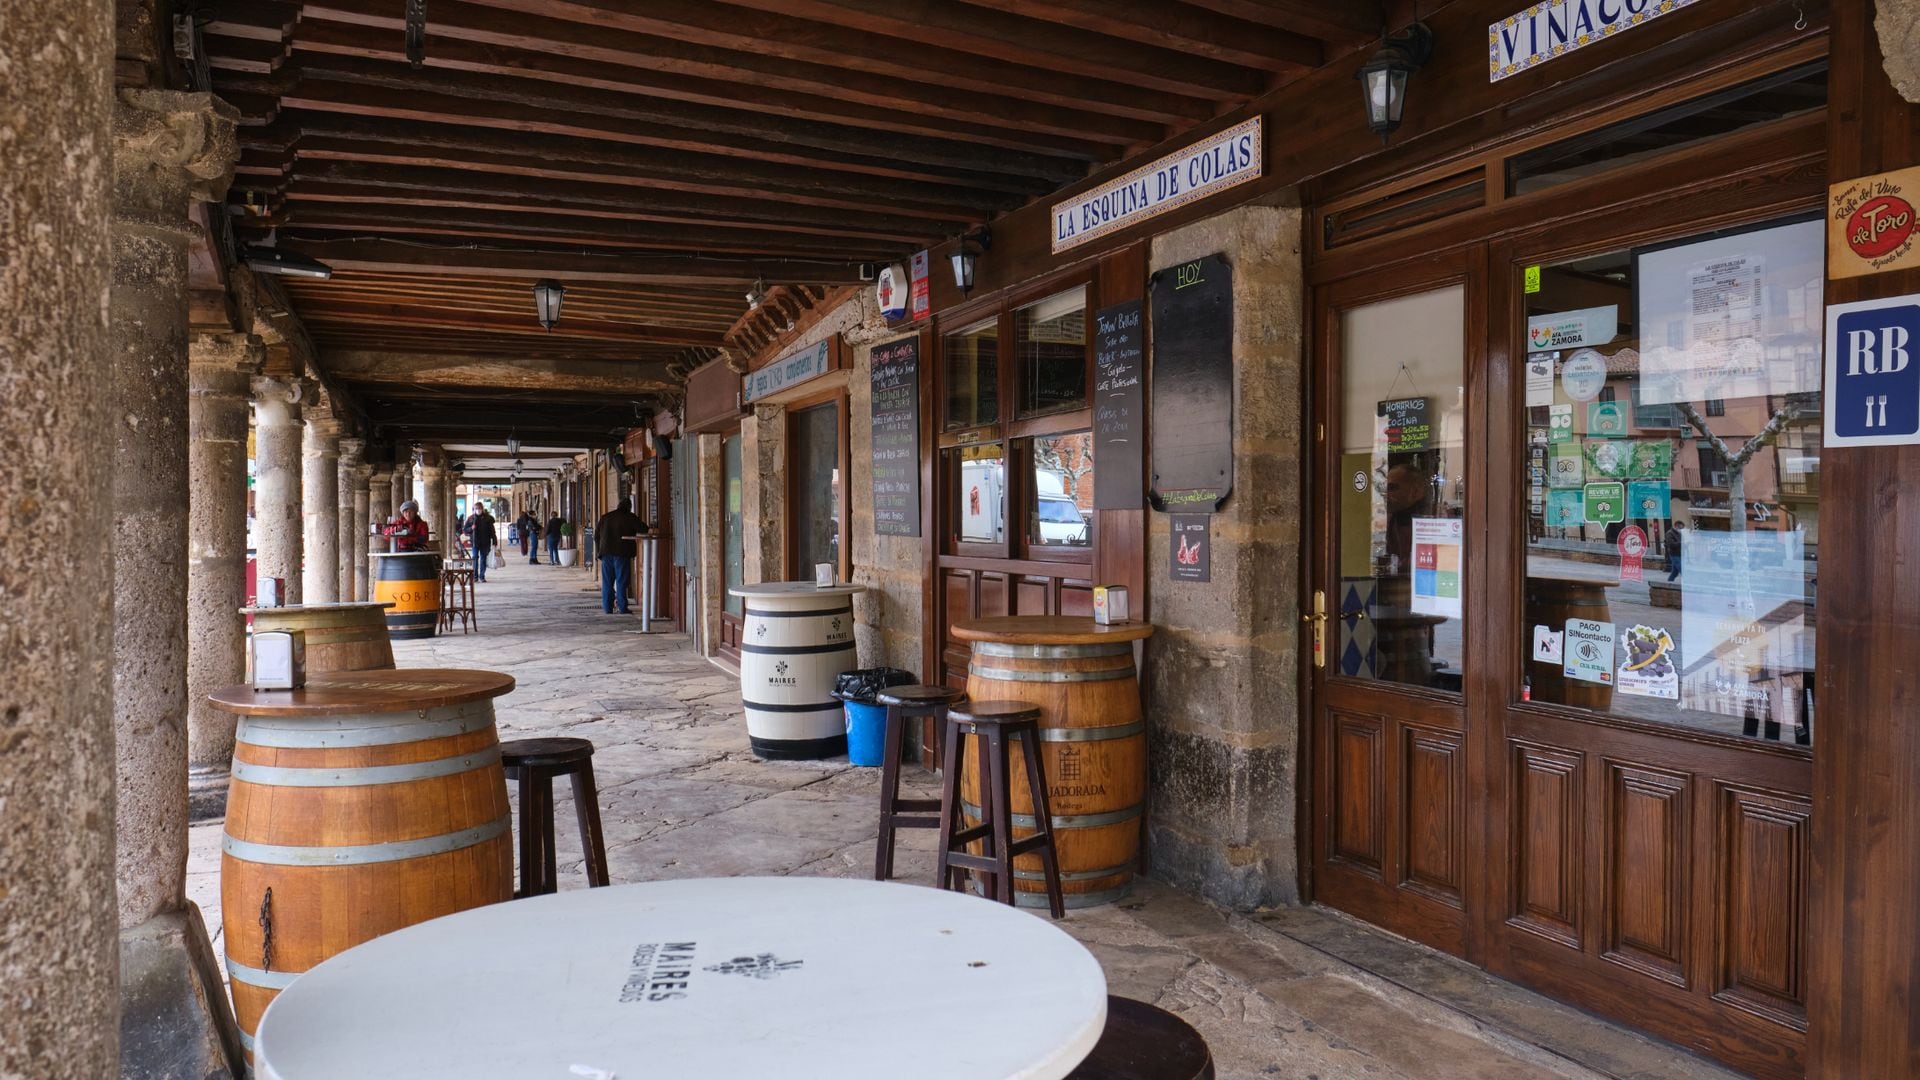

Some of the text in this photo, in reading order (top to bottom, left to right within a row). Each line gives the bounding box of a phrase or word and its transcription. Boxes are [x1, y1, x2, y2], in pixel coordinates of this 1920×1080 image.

[1058, 134, 1251, 240] LA ESQUINA DE COLÁS
[1835, 178, 1902, 219] Ruta del Vino
[1862, 203, 1909, 243] Toro
[1177, 260, 1202, 287] HOY
[1552, 335, 1583, 346] ZAMORA
[1846, 326, 1909, 377] RB
[1386, 399, 1425, 412] HORARIOS
[1568, 629, 1612, 642] SINcontacto
[1580, 622, 1601, 632] PAGO
[648, 941, 696, 1002] MAIRES
